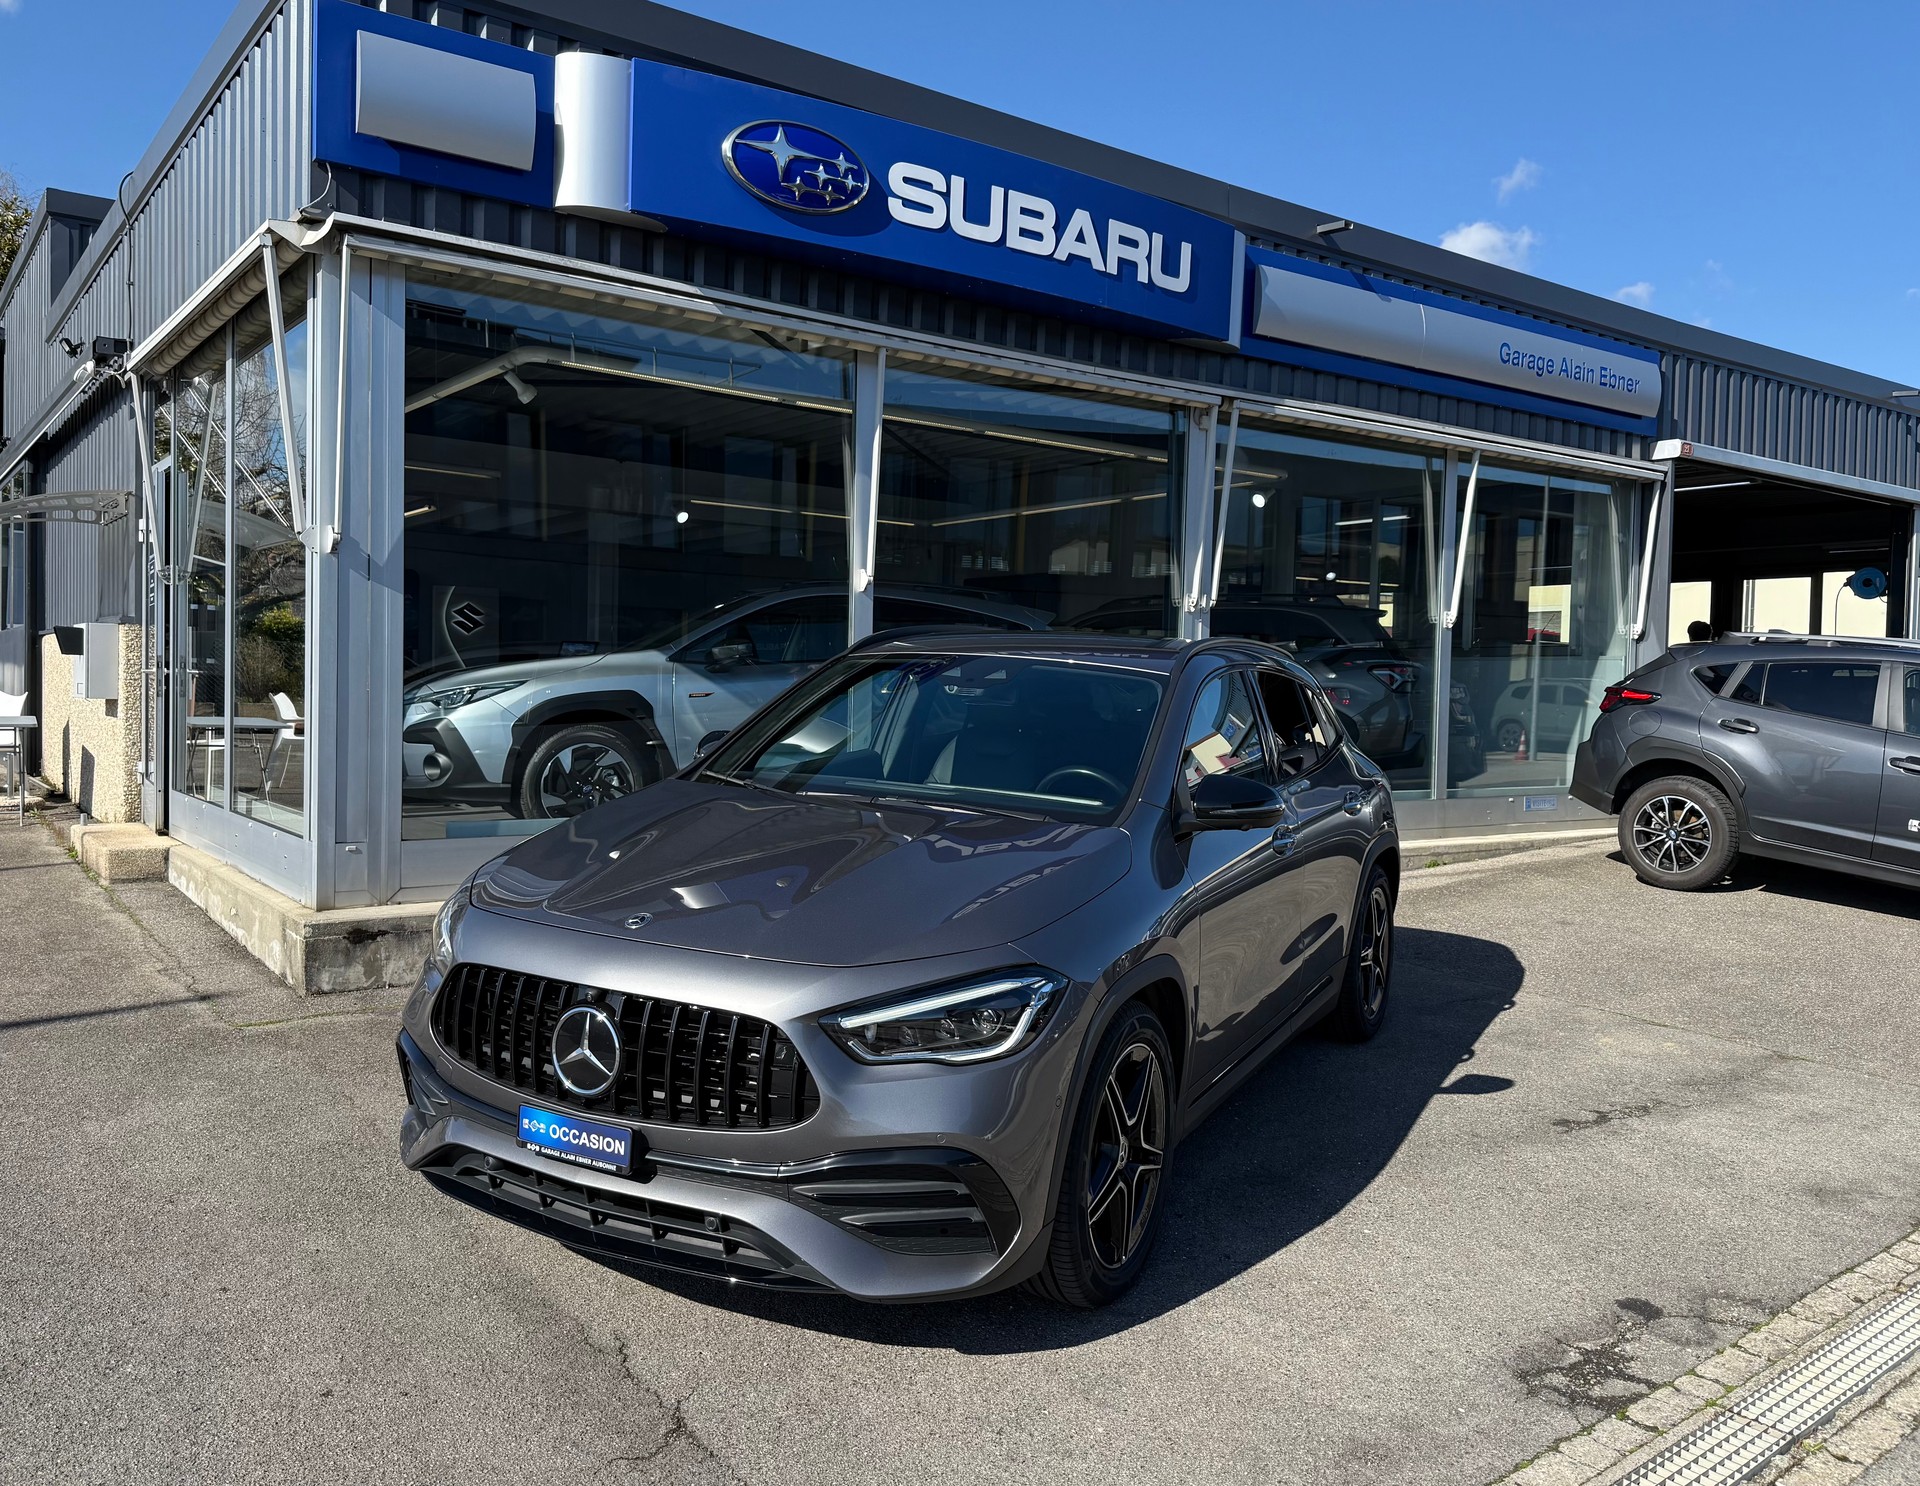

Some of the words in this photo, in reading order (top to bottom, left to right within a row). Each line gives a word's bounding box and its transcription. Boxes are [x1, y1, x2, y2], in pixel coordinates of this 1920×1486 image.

[888, 161, 1192, 293] SUBARU
[1499, 342, 1555, 377] Garage
[1558, 357, 1595, 384] Alain
[1599, 366, 1641, 394] Ebner
[541, 1146, 561, 1157] GARAGE
[560, 1152, 576, 1161] ALAIN
[592, 1160, 617, 1171] AUBONNE
[549, 1124, 625, 1156] OCCASION
